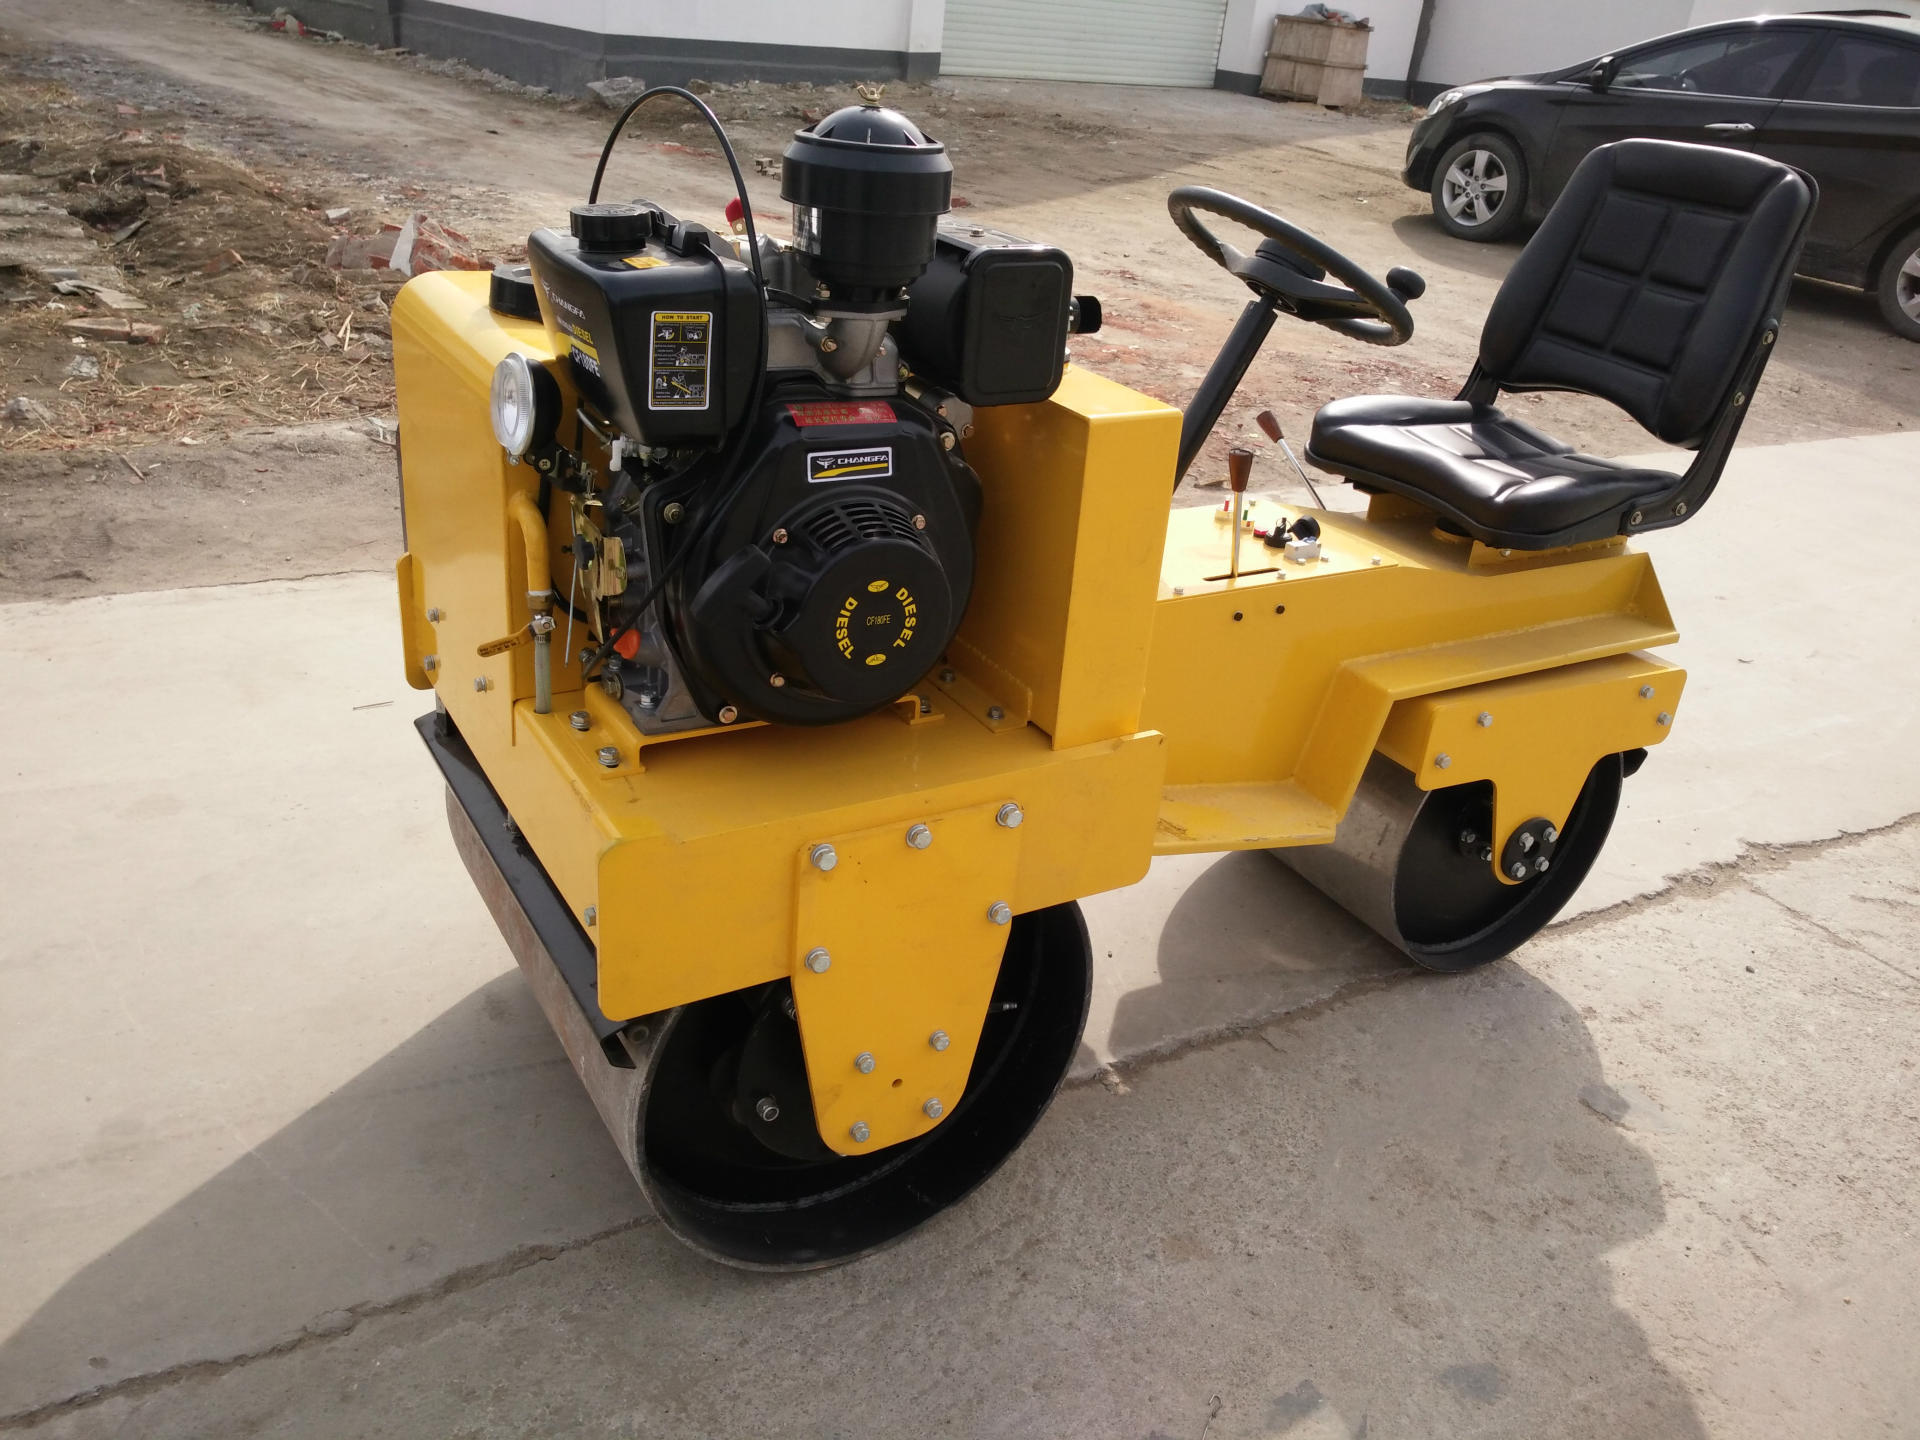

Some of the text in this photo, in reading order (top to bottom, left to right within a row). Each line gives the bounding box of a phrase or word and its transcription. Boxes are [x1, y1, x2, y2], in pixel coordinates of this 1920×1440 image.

[550, 291, 586, 320] CHANGFA
[571, 324, 594, 345] DIESEL
[837, 455, 888, 465] CHANGFA
[836, 596, 859, 660] DIESEL
[893, 587, 917, 648] DIESEL
